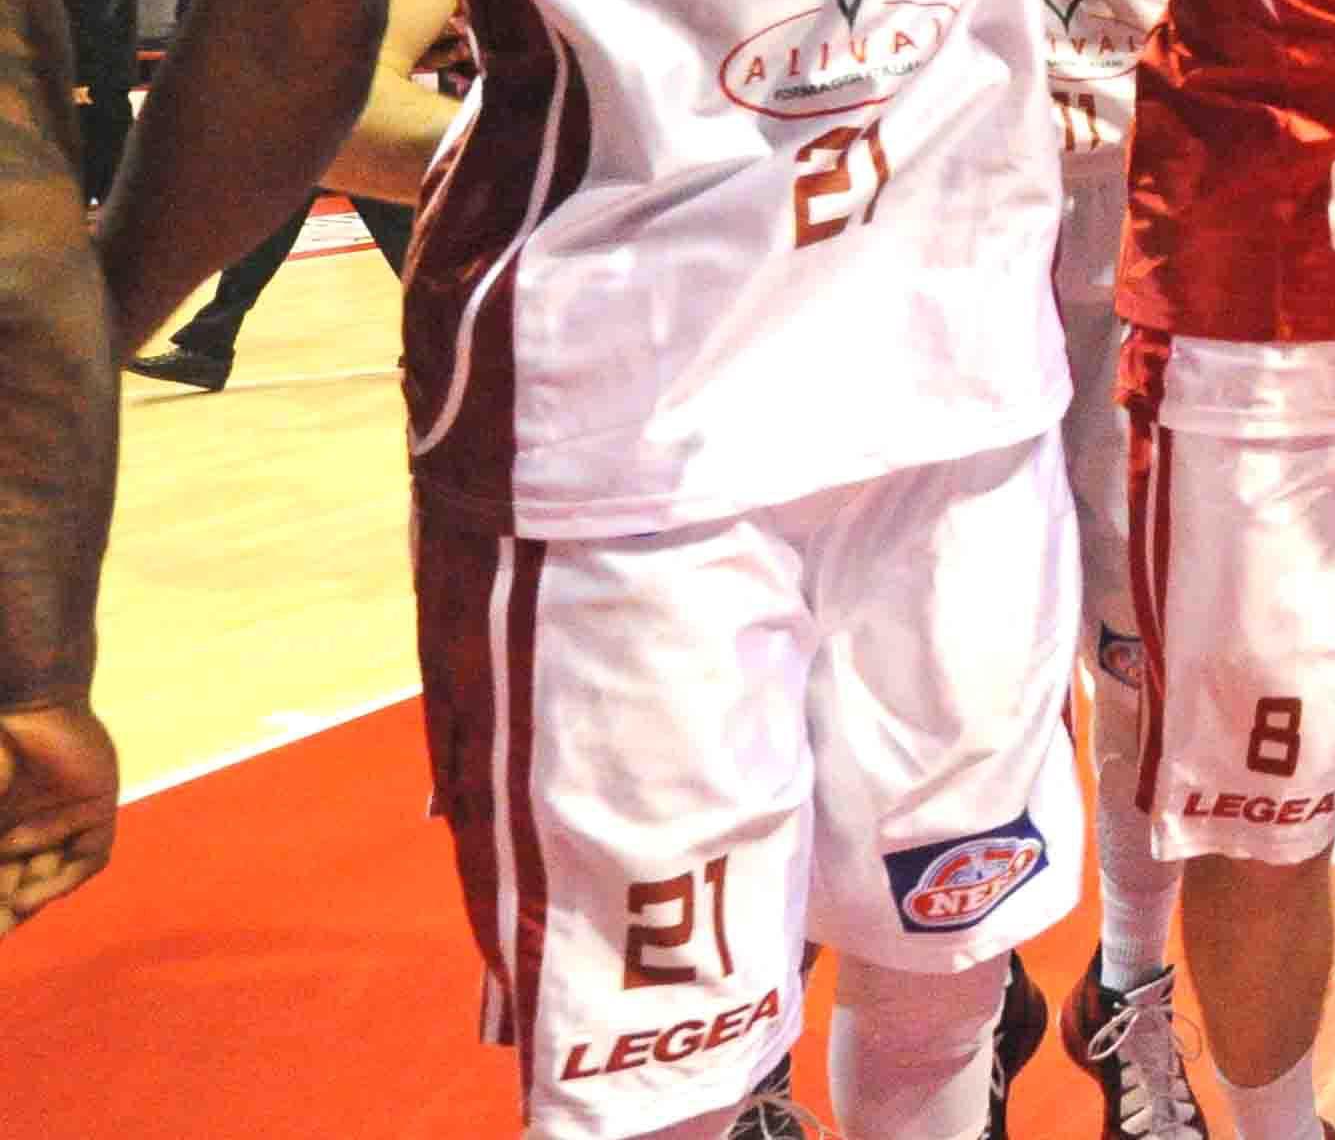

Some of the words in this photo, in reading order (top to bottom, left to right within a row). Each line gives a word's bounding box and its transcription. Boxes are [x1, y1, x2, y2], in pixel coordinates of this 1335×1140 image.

[794, 118, 891, 250] 21
[1246, 696, 1302, 779] 8
[623, 854, 735, 991] 21
[561, 988, 781, 1083] LEGEA
